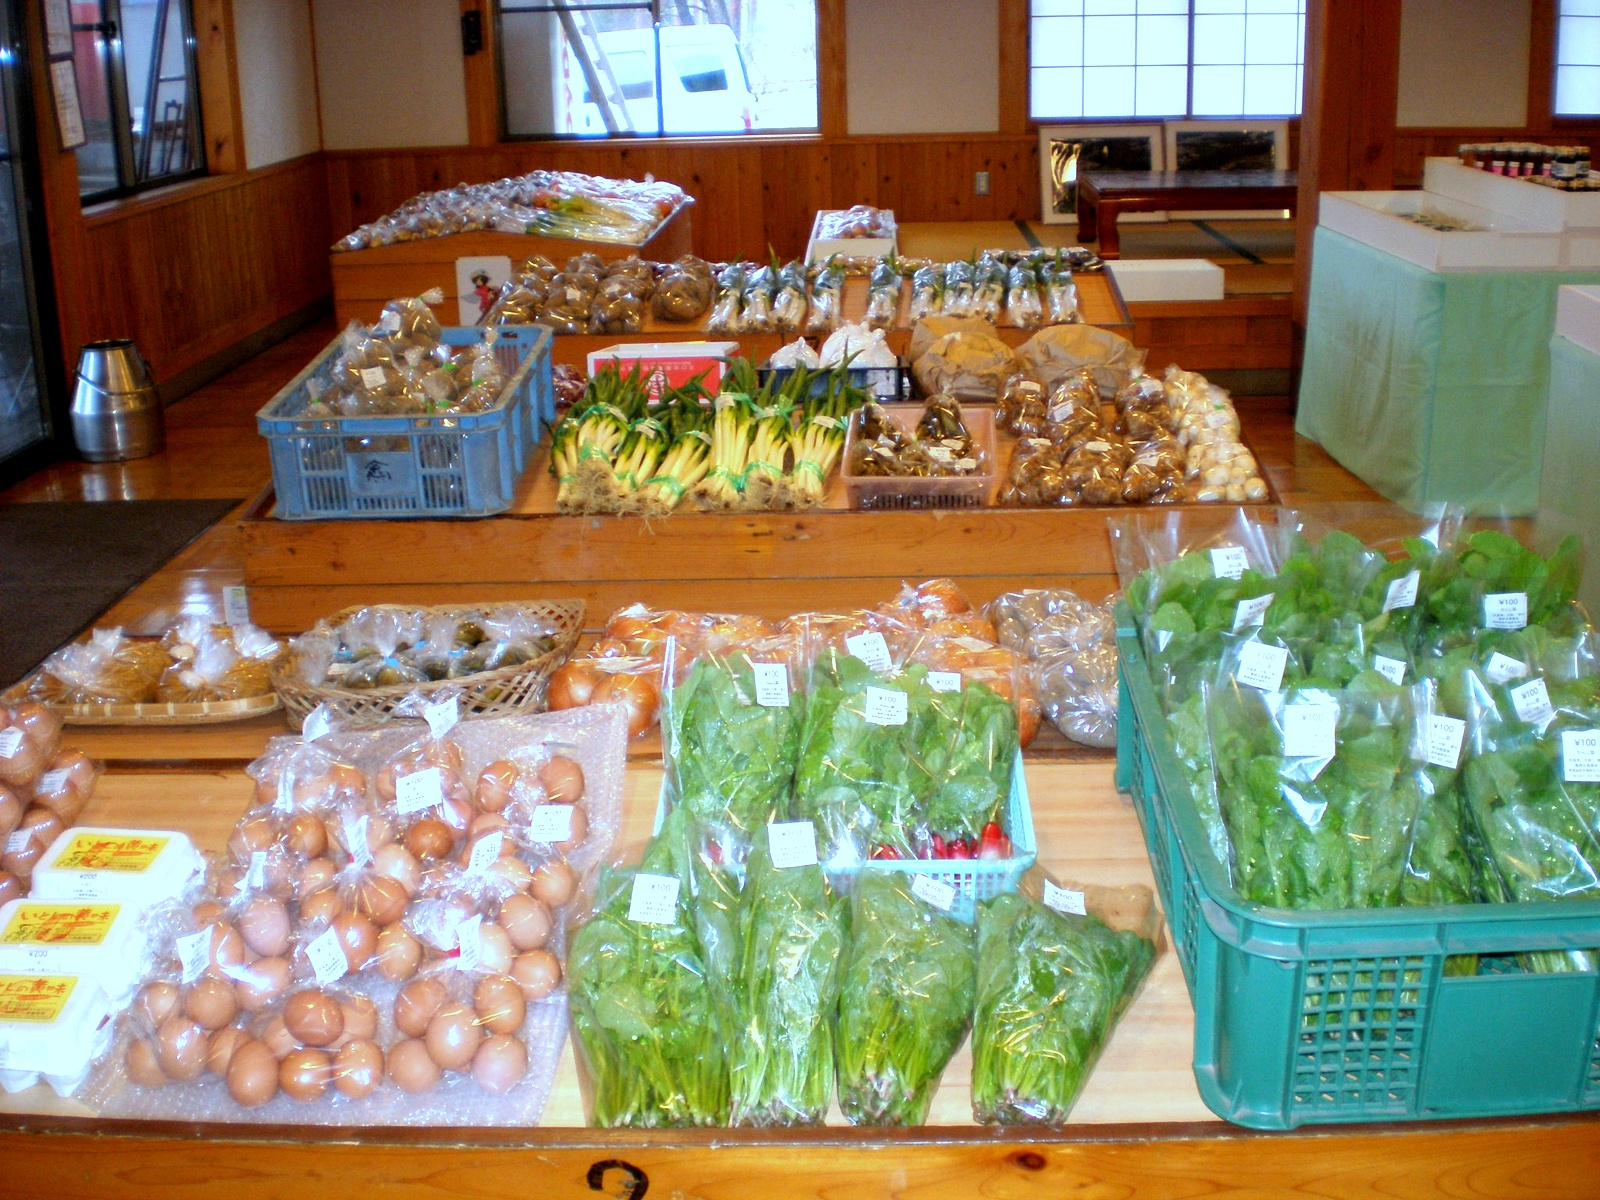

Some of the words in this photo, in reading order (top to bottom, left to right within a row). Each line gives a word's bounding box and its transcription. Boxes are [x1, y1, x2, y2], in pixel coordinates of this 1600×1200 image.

[1499, 598, 1518, 606] ¥100
[862, 639, 879, 647] ¥100
[1381, 664, 1397, 675] ¥100
[935, 678, 955, 686] ¥100
[1520, 687, 1539, 699] ¥100
[878, 695, 897, 703] ¥100
[1433, 722, 1455, 733] ¥100
[1573, 738, 1597, 747] ¥100
[651, 883, 671, 892] ¥100
